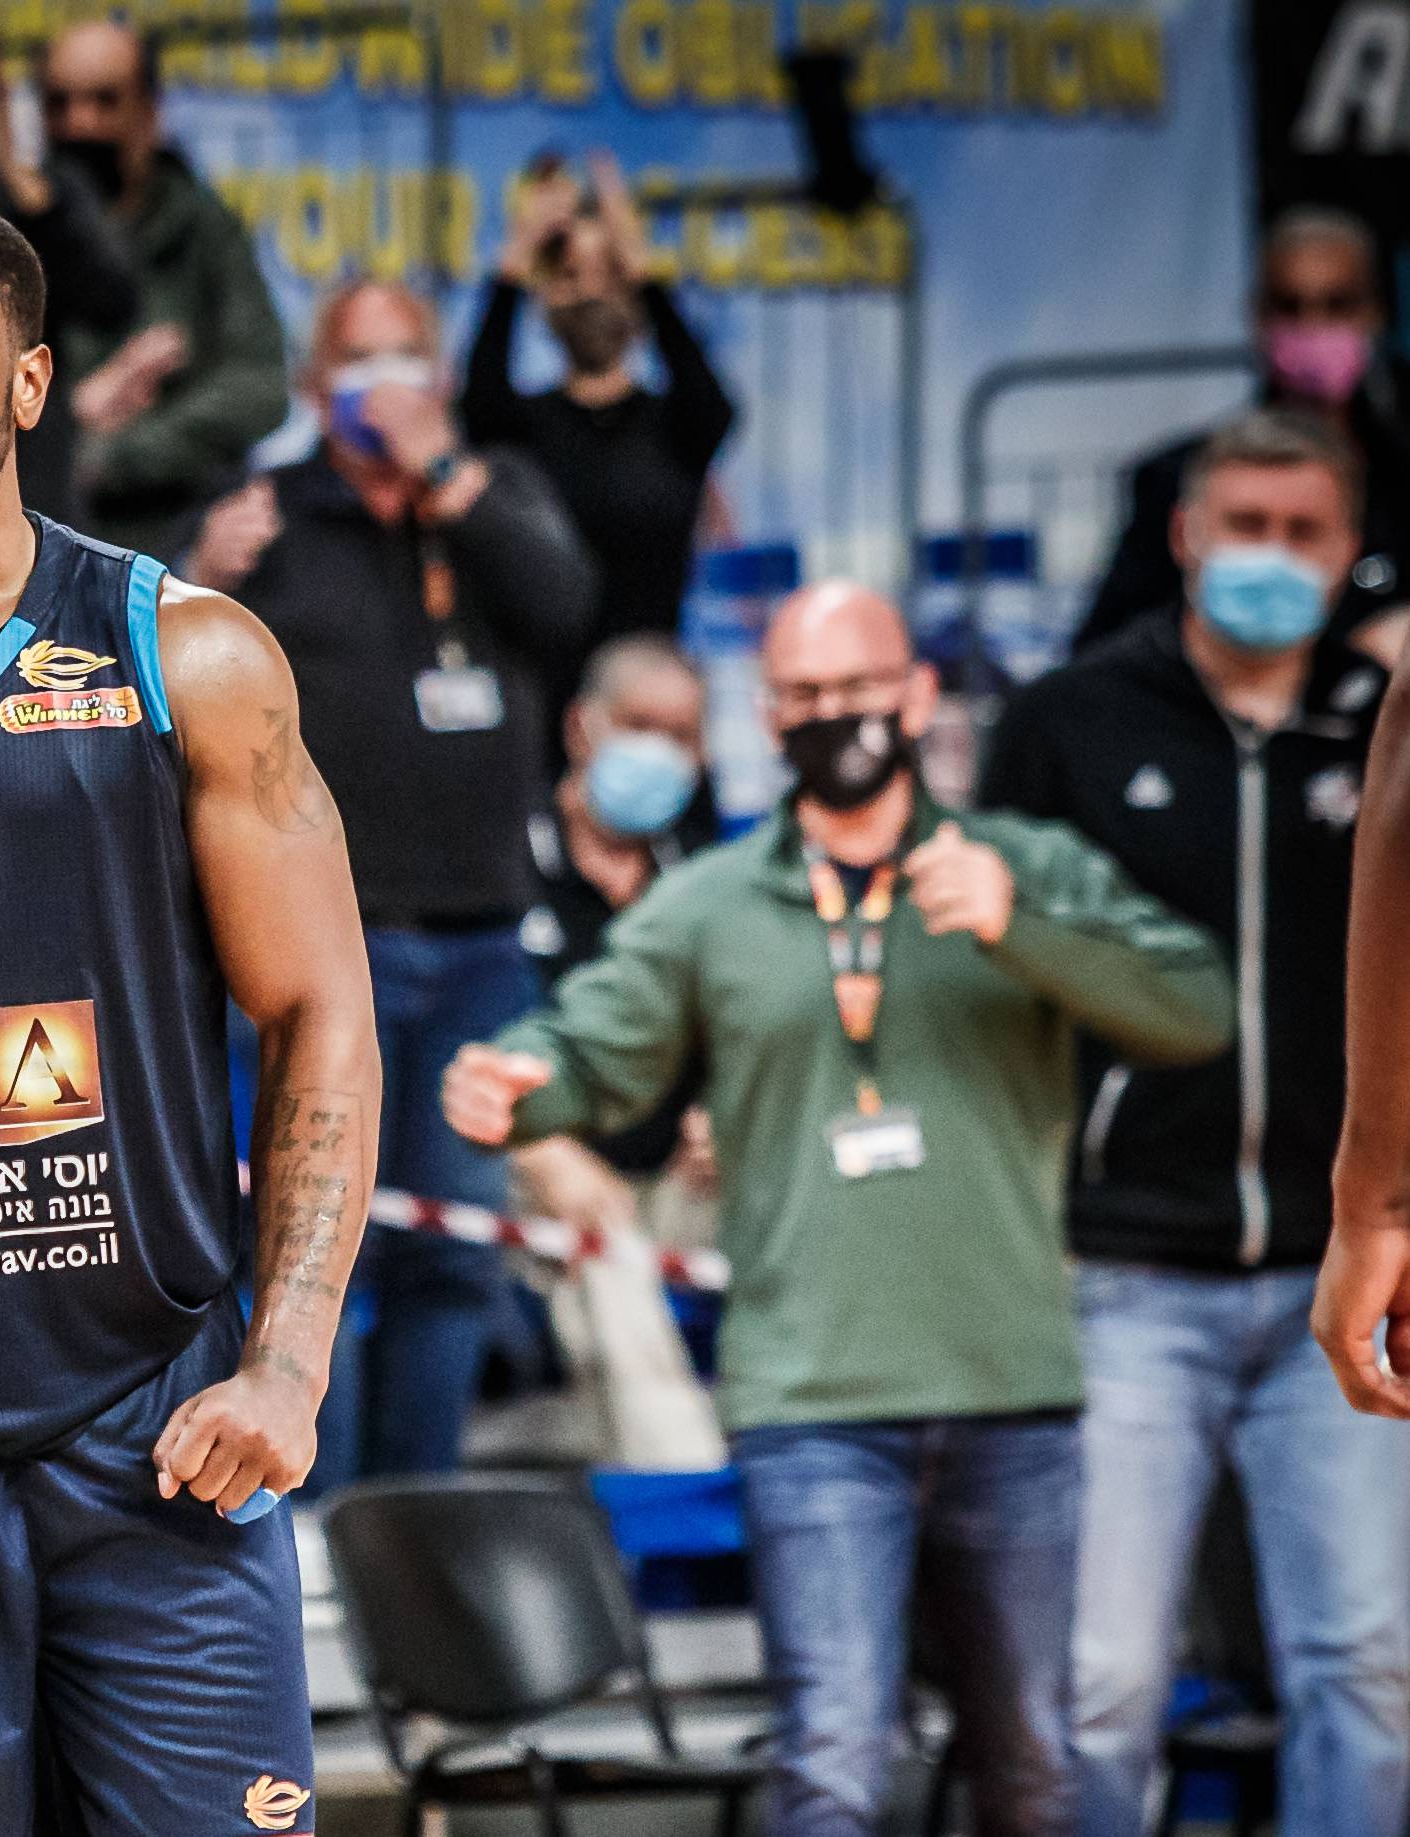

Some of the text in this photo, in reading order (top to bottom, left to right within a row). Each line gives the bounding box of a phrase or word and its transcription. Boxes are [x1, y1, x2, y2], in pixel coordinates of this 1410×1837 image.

[0, 1017, 91, 1112] A
[42, 1152, 108, 1188] יוסי
[48, 1193, 112, 1220] בונה
